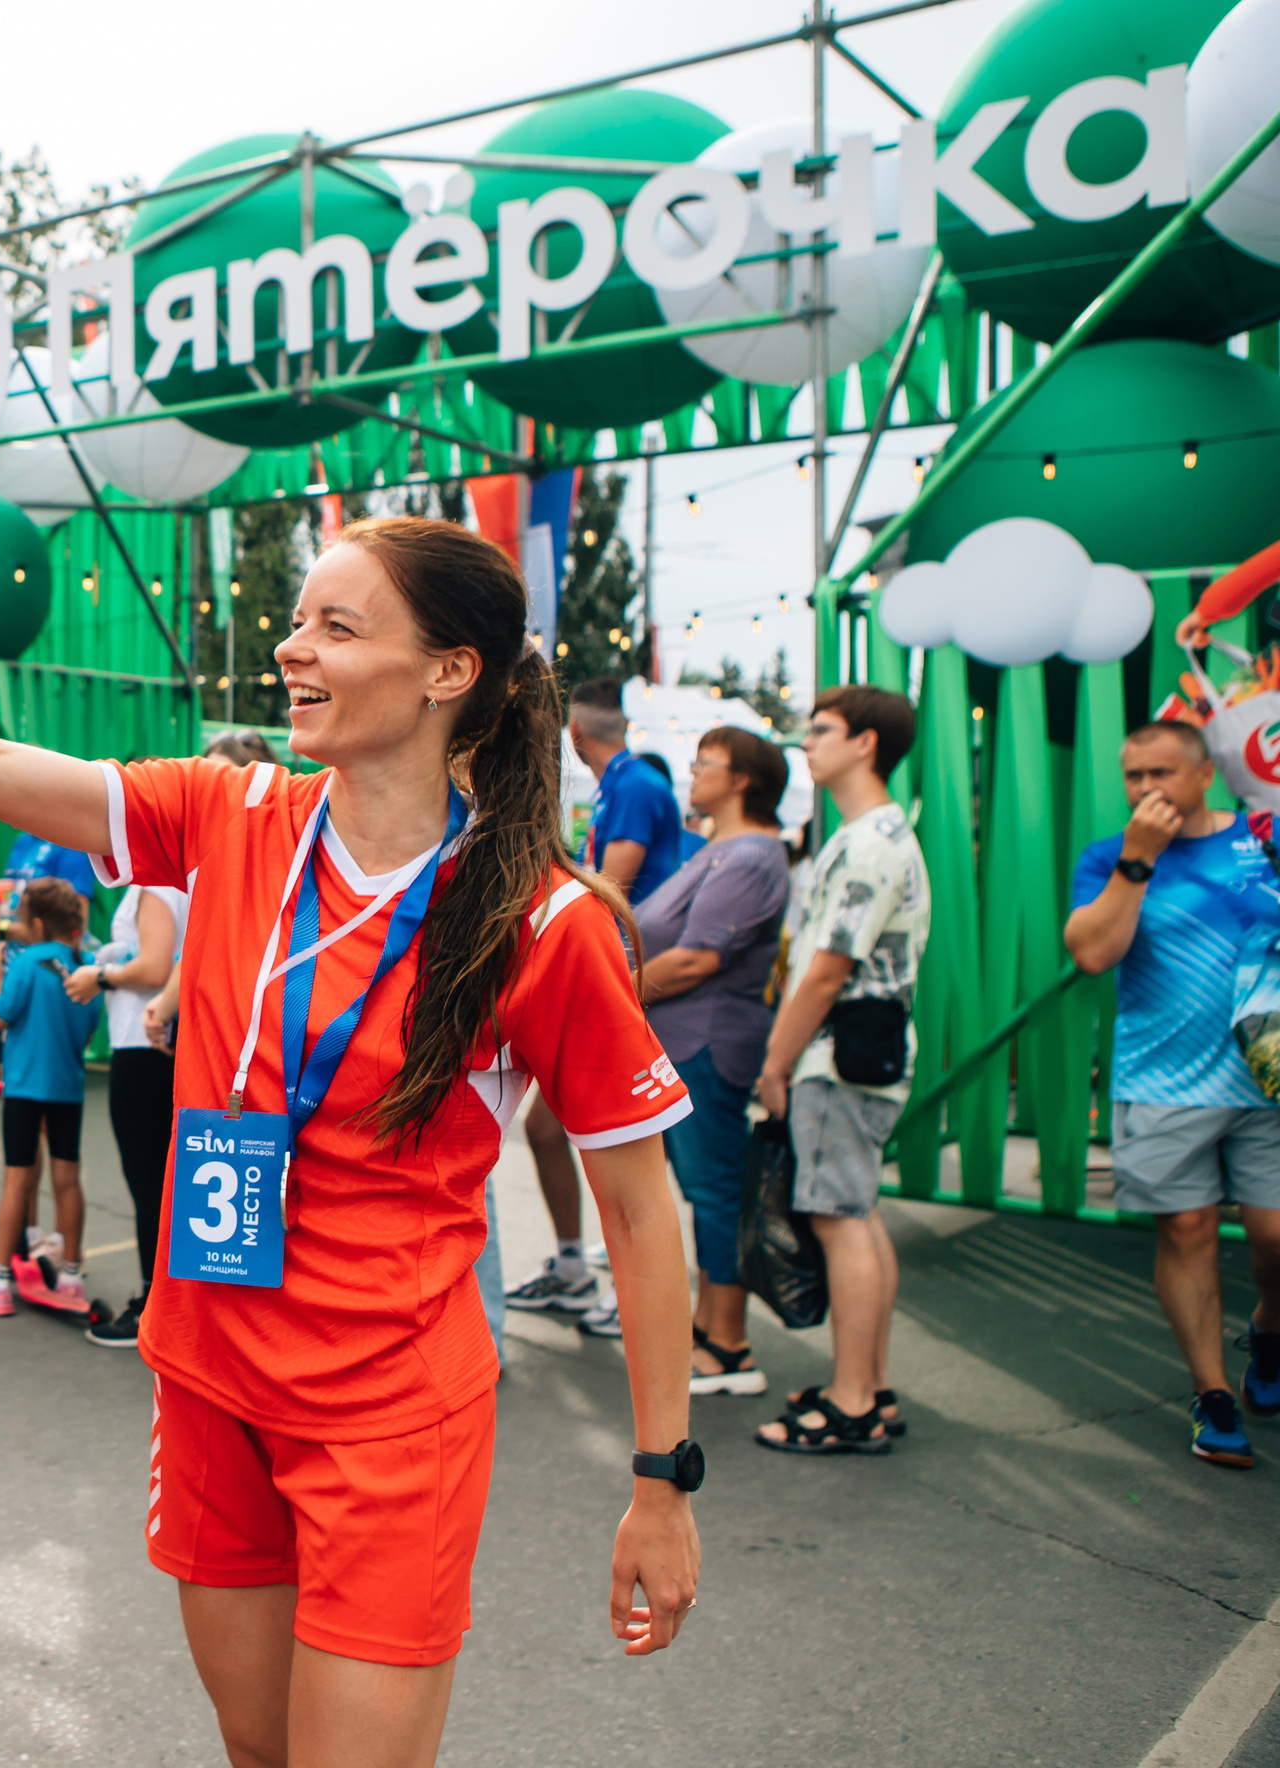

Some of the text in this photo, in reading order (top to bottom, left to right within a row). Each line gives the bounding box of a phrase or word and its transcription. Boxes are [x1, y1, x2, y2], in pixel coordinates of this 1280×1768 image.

[47, 62, 1190, 395] Пятёрочка
[240, 1138, 276, 1147] СИБИРСКИЙ
[240, 1148, 275, 1157] МАРАФОН
[188, 1160, 239, 1243] 3
[242, 1166, 262, 1246] МЕСТО
[206, 1251, 243, 1265] 10 КМ
[199, 1264, 248, 1276] ЖЕНЩИНЫ
